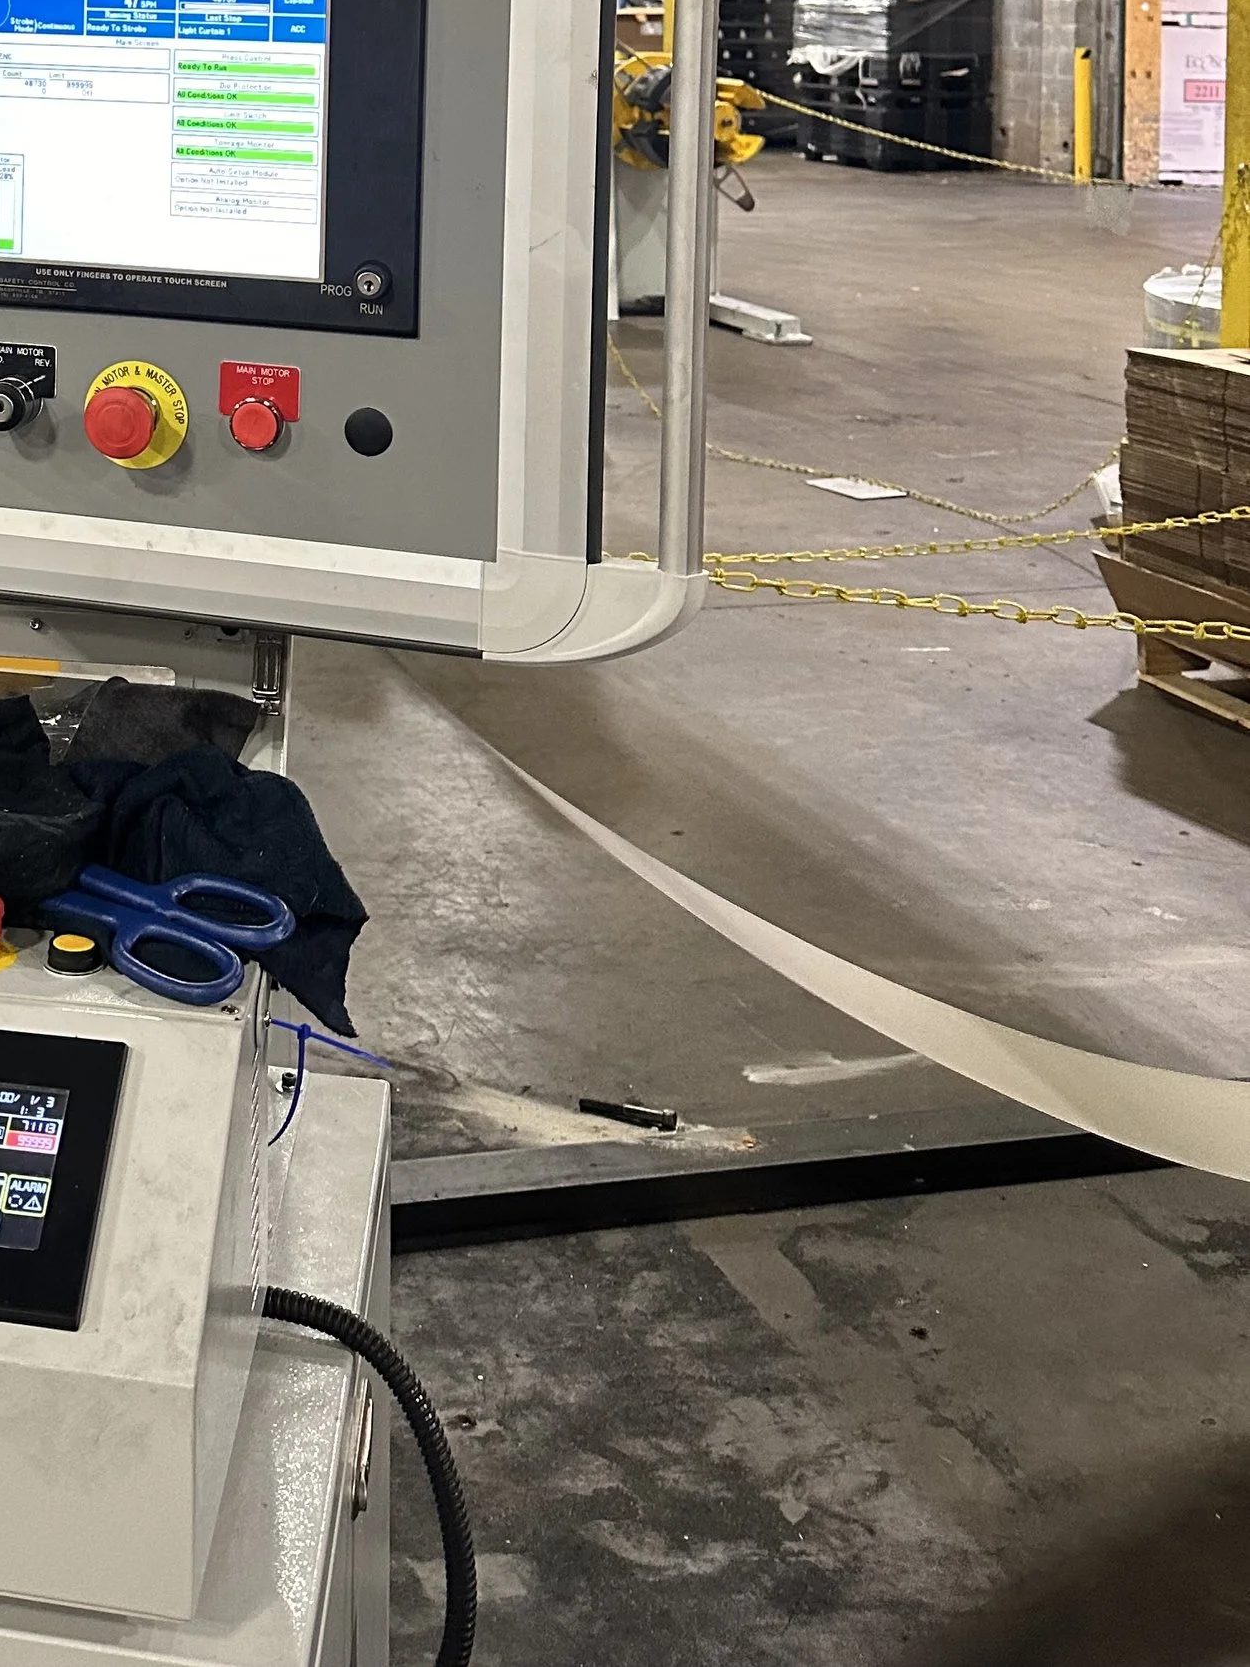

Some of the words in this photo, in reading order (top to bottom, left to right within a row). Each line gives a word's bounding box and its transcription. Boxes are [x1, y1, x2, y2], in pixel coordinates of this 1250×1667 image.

[133, 12, 157, 20] Status
[205, 14, 221, 22] Last
[223, 15, 243, 23] Stop
[37, 22, 76, 31] Continuous
[87, 23, 110, 32] Ready
[111, 24, 121, 32] To
[178, 26, 198, 35] Light
[198, 26, 226, 35] Curtain
[290, 25, 306, 33] ACC
[178, 62, 200, 72] Ready
[203, 63, 212, 71] To
[214, 63, 227, 71] Run
[2, 69, 22, 77] Count
[187, 91, 225, 100] Conditions
[226, 93, 237, 101] OK
[176, 119, 185, 127] All
[186, 120, 224, 129] Conditions
[225, 121, 237, 129] OK
[175, 147, 185, 156] All
[186, 148, 223, 157] Conditions
[225, 150, 236, 158] OK
[35, 267, 51, 276] USE
[53, 269, 74, 278] ONLY
[76, 271, 111, 280] FINGERS
[112, 273, 123, 281] TO
[125, 274, 162, 284] OPERATE
[164, 276, 192, 285] TOUCH
[194, 278, 227, 288] SCREEN
[320, 284, 352, 297] PROG
[359, 303, 384, 315] RUN
[16, 348, 44, 357] MOTOR
[236, 365, 256, 375] MAIN
[261, 367, 290, 377] MOTOR
[251, 376, 274, 385] STOP
[102, 366, 130, 386] MOTOR
[134, 365, 140, 375] &
[145, 368, 177, 398] MASTER
[172, 399, 185, 425] STOP
[10, 1179, 47, 1194] ALARM
